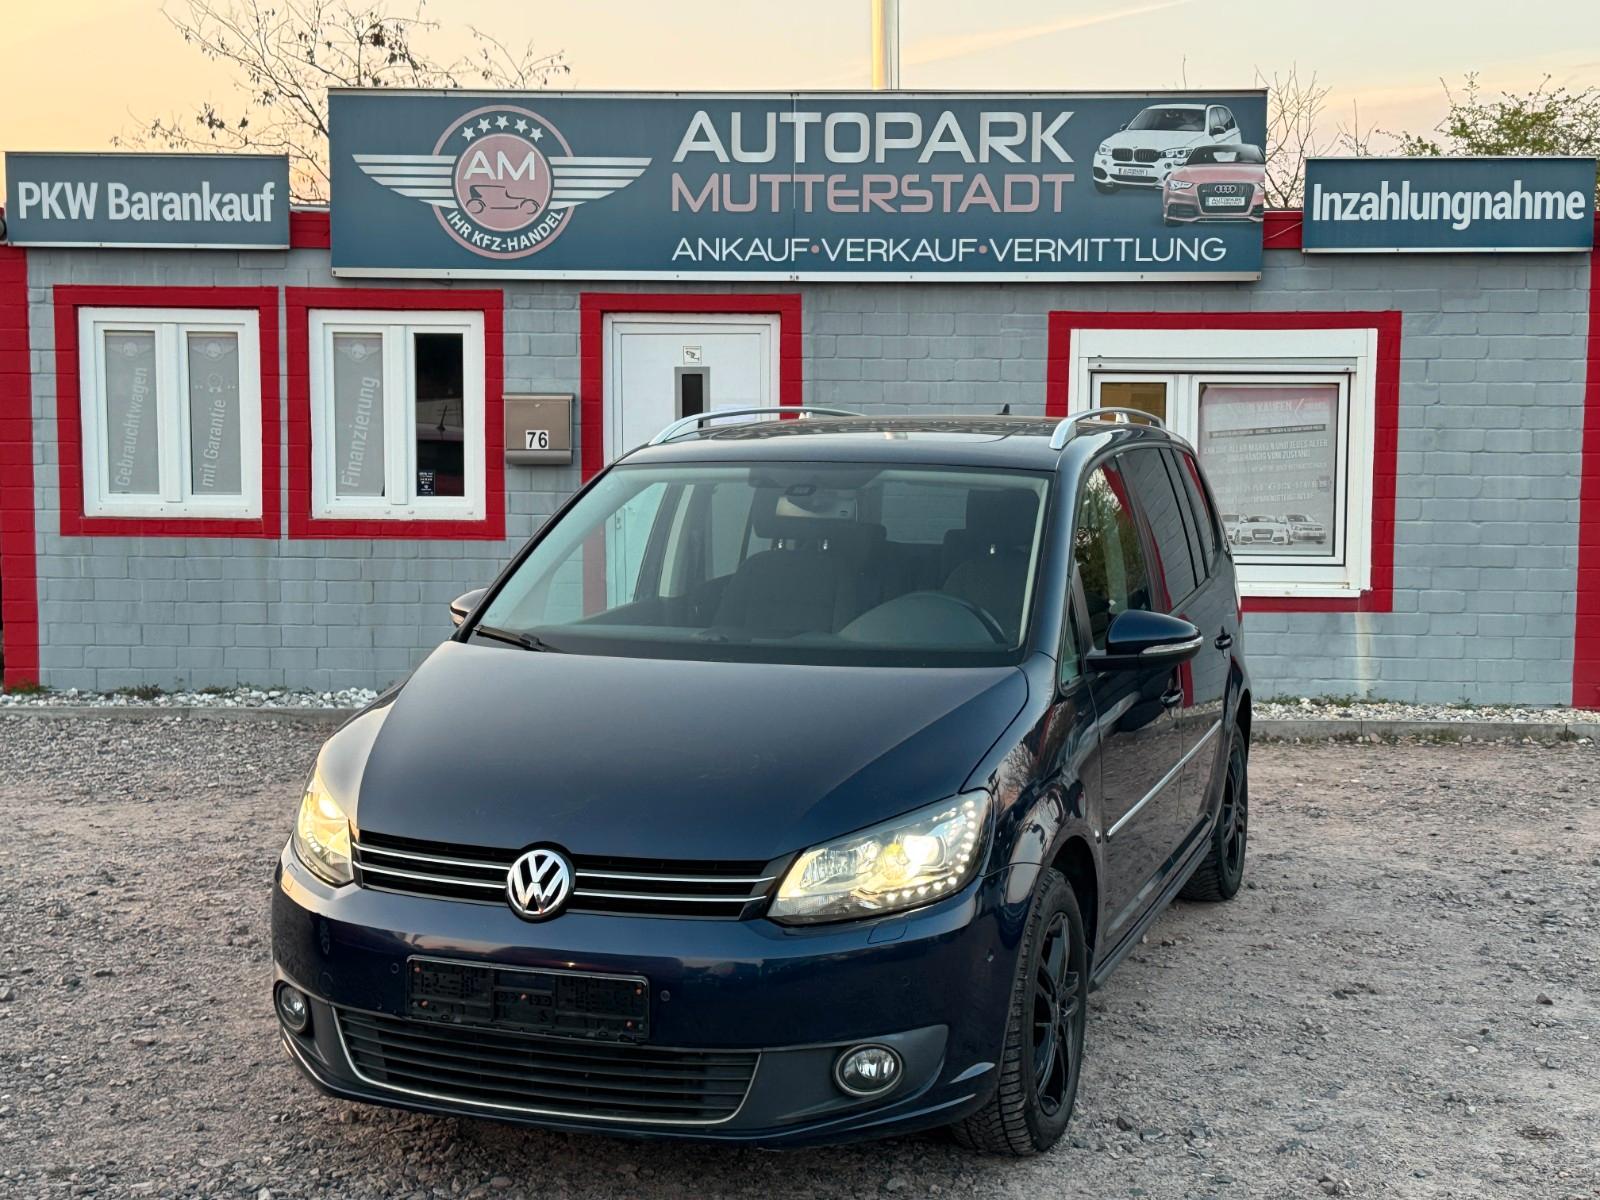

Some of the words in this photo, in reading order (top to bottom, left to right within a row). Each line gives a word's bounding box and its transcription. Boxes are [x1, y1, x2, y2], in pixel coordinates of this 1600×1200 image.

[671, 110, 1075, 164] AUTOPARK
[463, 150, 536, 181] AM
[18, 181, 99, 220] PKW
[107, 181, 275, 222] Barankauf
[671, 172, 1075, 213] MUTTERSTADT
[1312, 179, 1586, 231] Inzahlungnahme
[446, 210, 472, 239] IHR
[471, 210, 564, 251] KFZ-HANDEL
[671, 237, 811, 262] ANKAUF
[821, 237, 978, 262] VERKAUF
[989, 237, 1227, 262] VERMITTLUNG
[115, 366, 149, 487] Gebrauchtwagen
[203, 398, 226, 460] Garantie
[341, 376, 381, 487] Finanzierung
[527, 431, 548, 449] 76
[200, 462, 217, 488] mit
